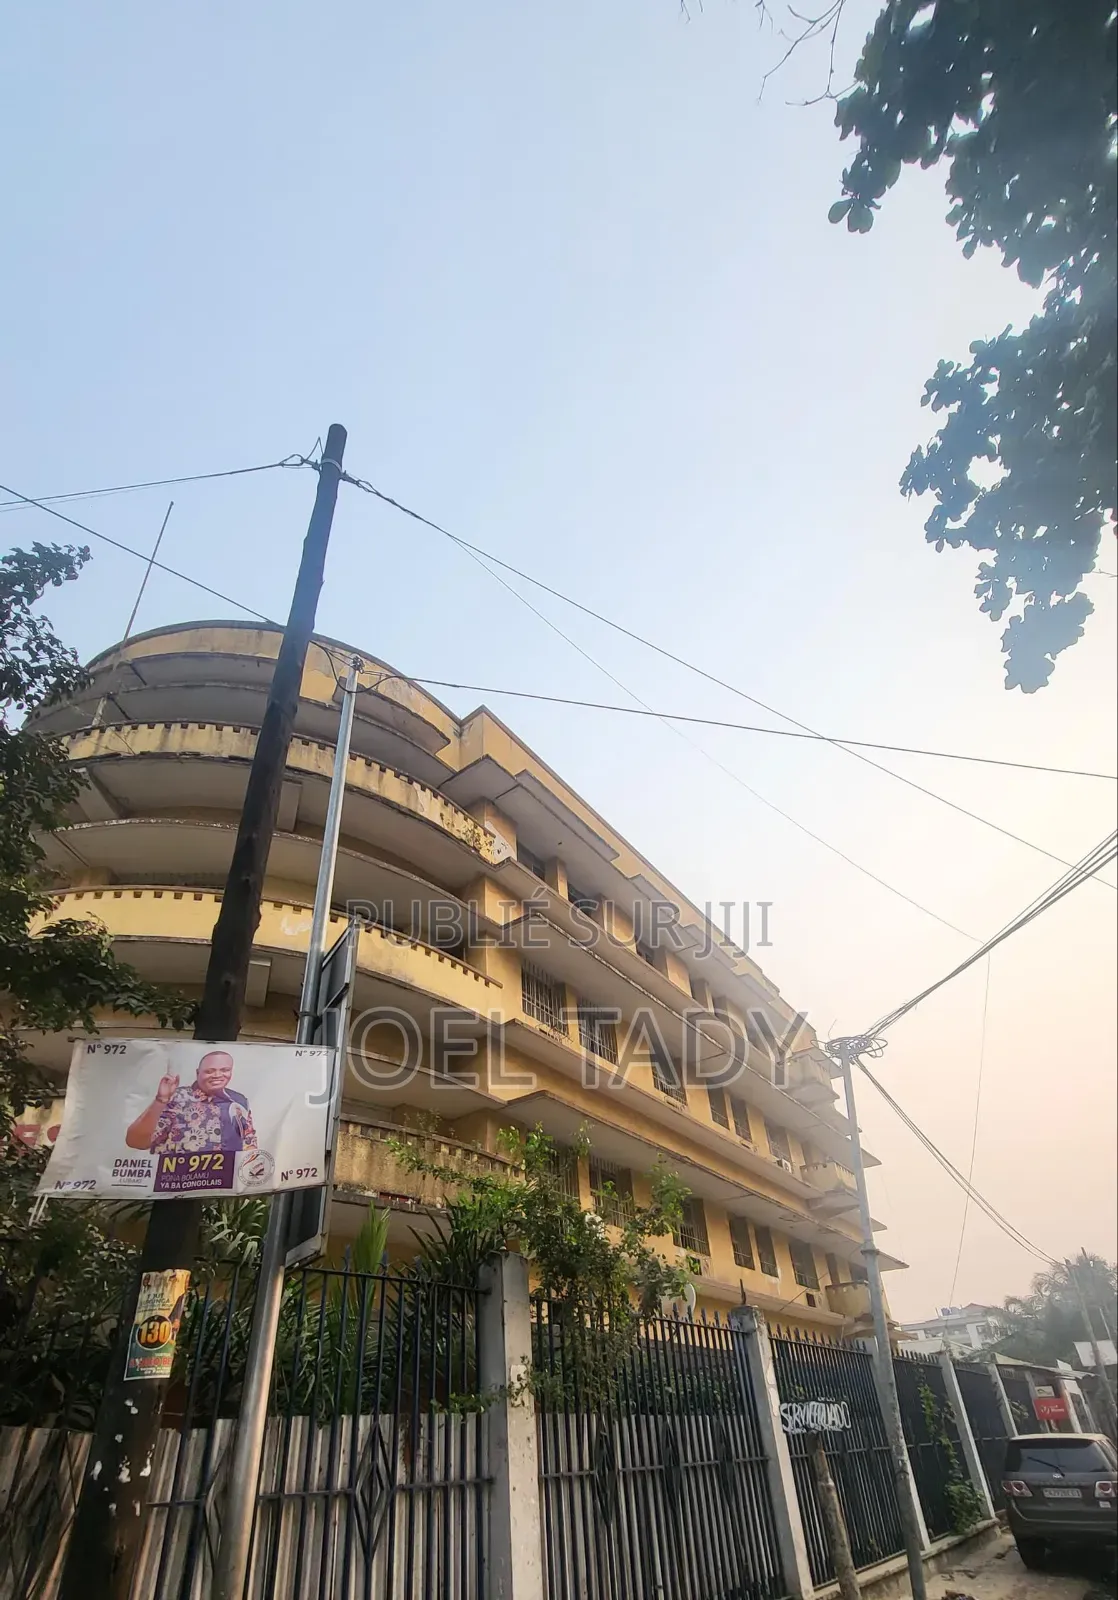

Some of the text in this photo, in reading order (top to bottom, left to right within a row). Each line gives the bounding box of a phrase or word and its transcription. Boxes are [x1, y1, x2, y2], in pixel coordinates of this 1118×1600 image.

[87, 1044, 127, 1055] N° 972
[114, 1158, 153, 1168] DANIEL
[162, 1156, 185, 1173] N°
[189, 1154, 225, 1172] 972
[112, 1169, 151, 1178] BUMBA
[161, 1172, 210, 1182] PONA BOLAMU
[281, 1167, 318, 1182] N° 972
[72, 1179, 97, 1190] 972
[182, 1179, 222, 1188] CONGOLAIS
[139, 1321, 171, 1344] 130
